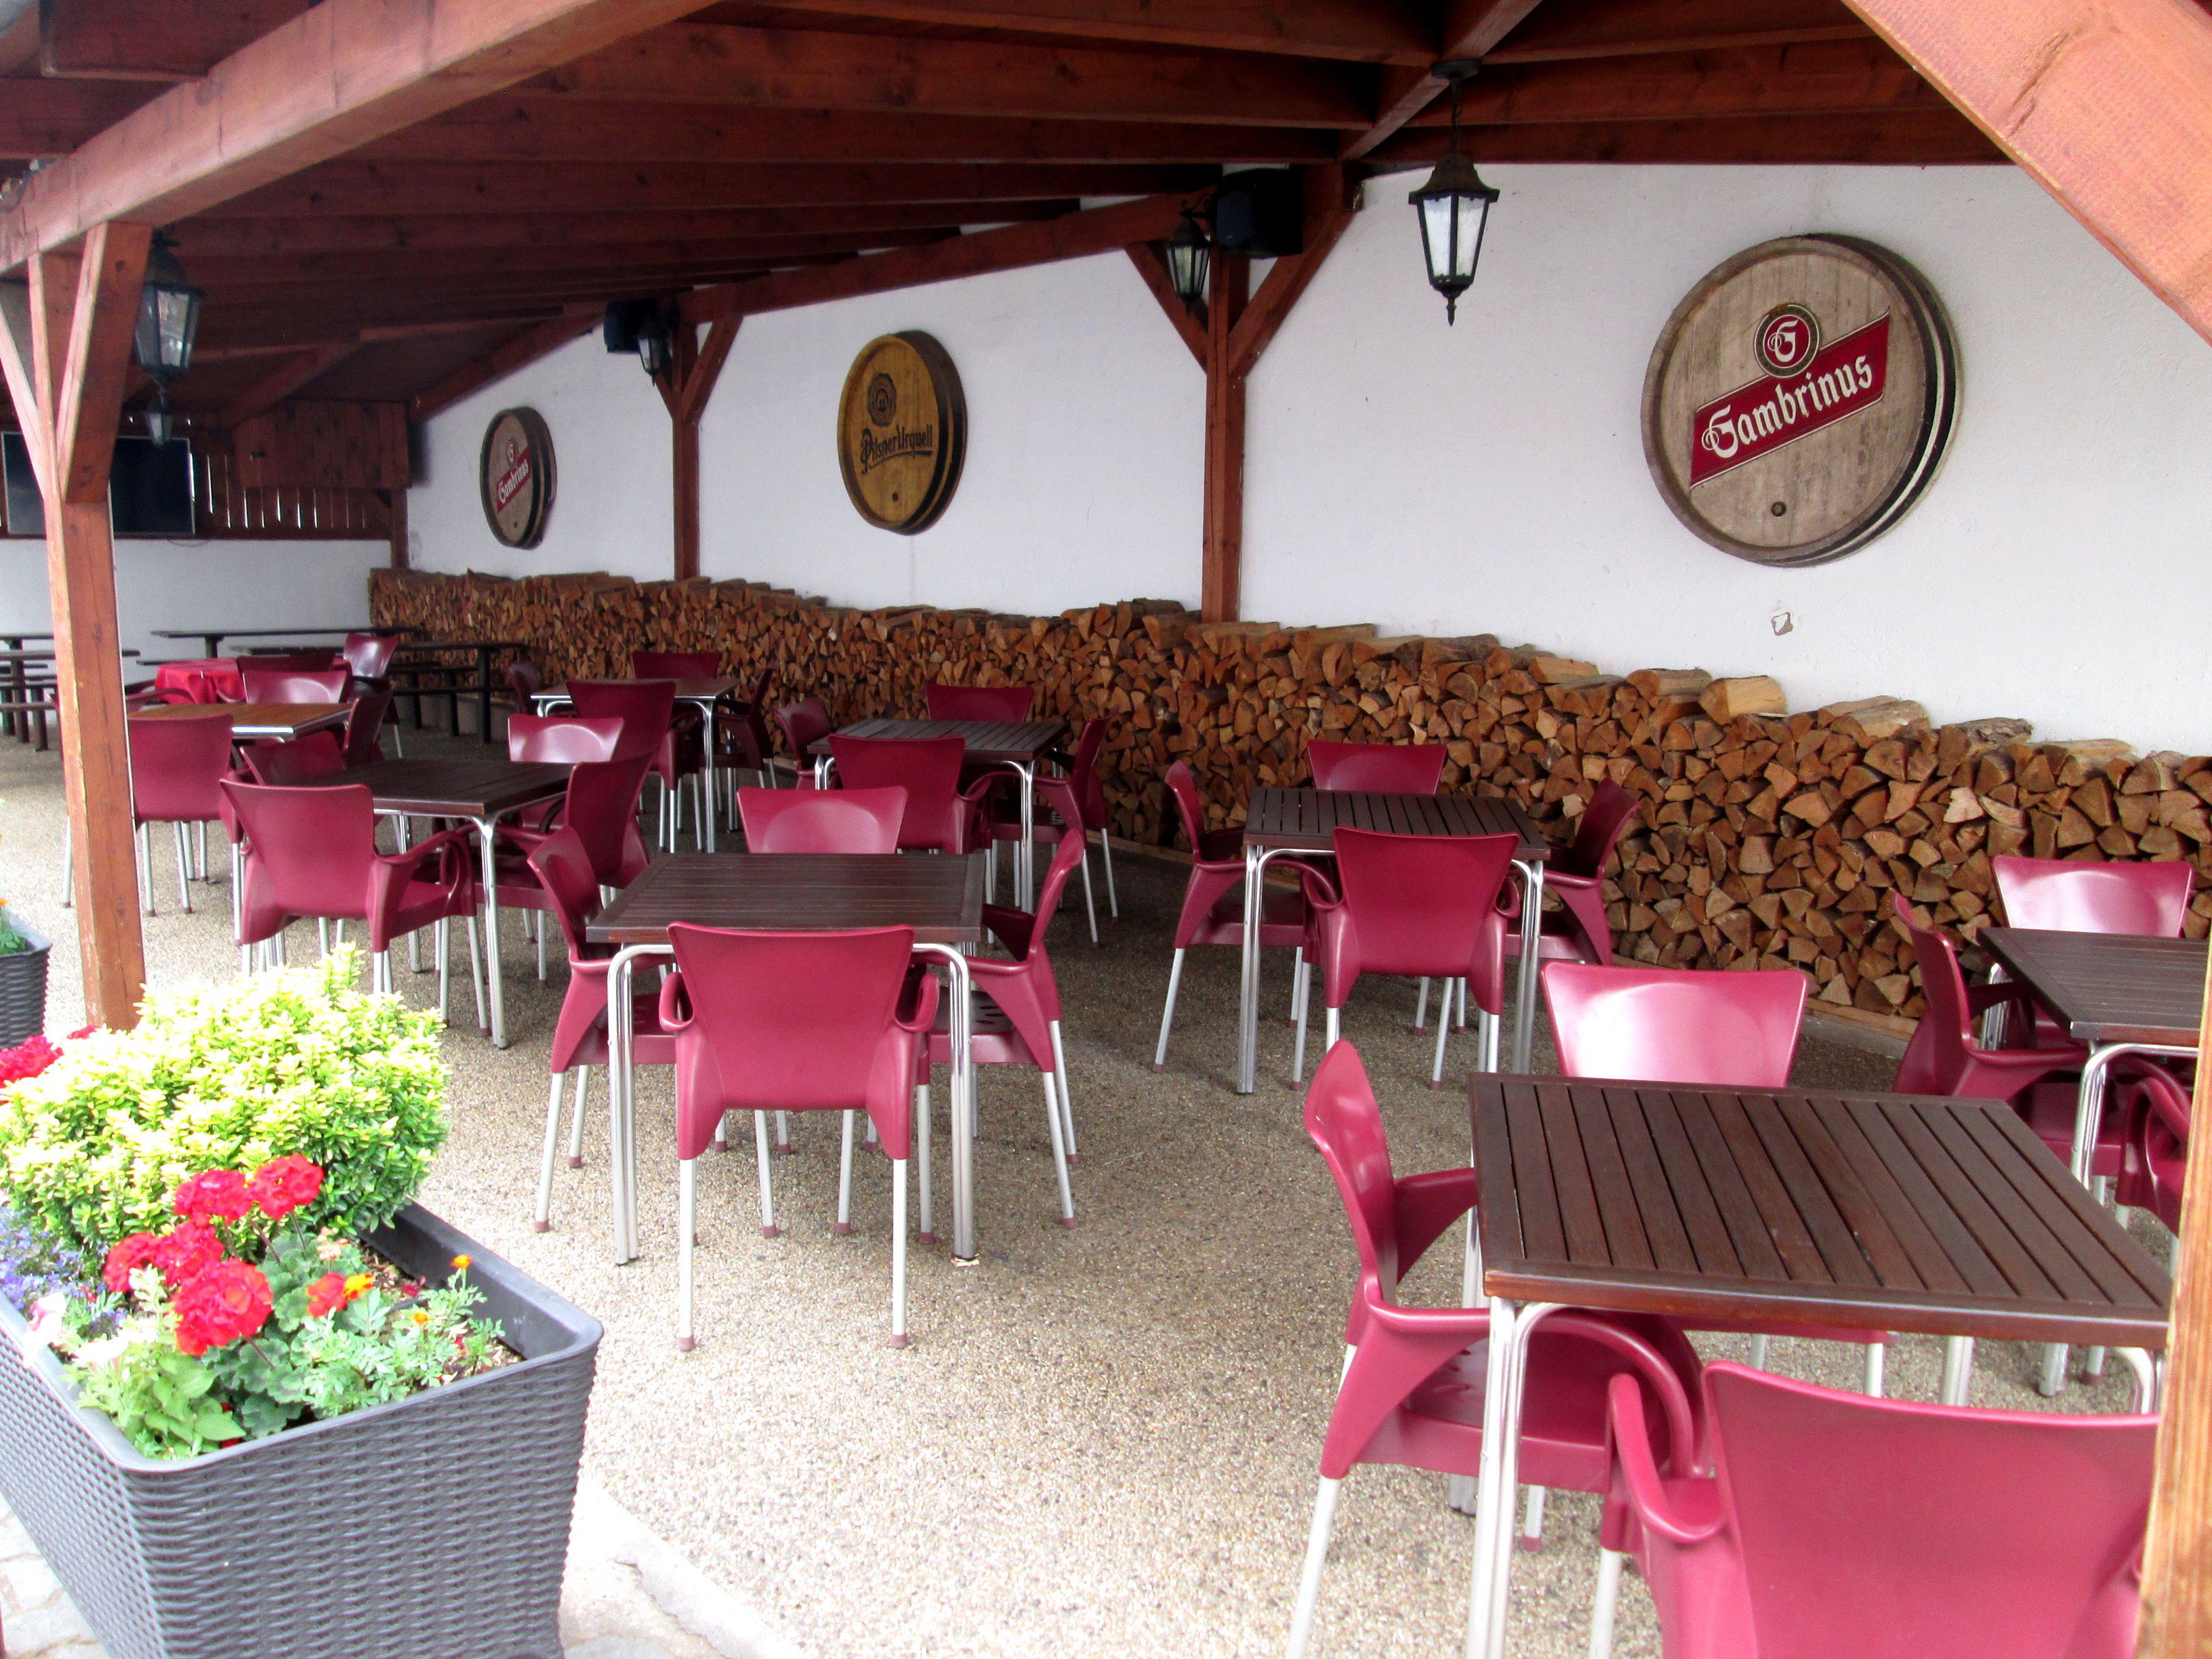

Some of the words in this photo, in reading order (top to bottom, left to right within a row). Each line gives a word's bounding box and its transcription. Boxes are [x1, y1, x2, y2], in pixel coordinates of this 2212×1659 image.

[1701, 355, 1872, 459] Gambrinus
[861, 428, 897, 474] Pilsner
[897, 424, 933, 459] Urquell
[498, 459, 529, 504] Gambrinus
